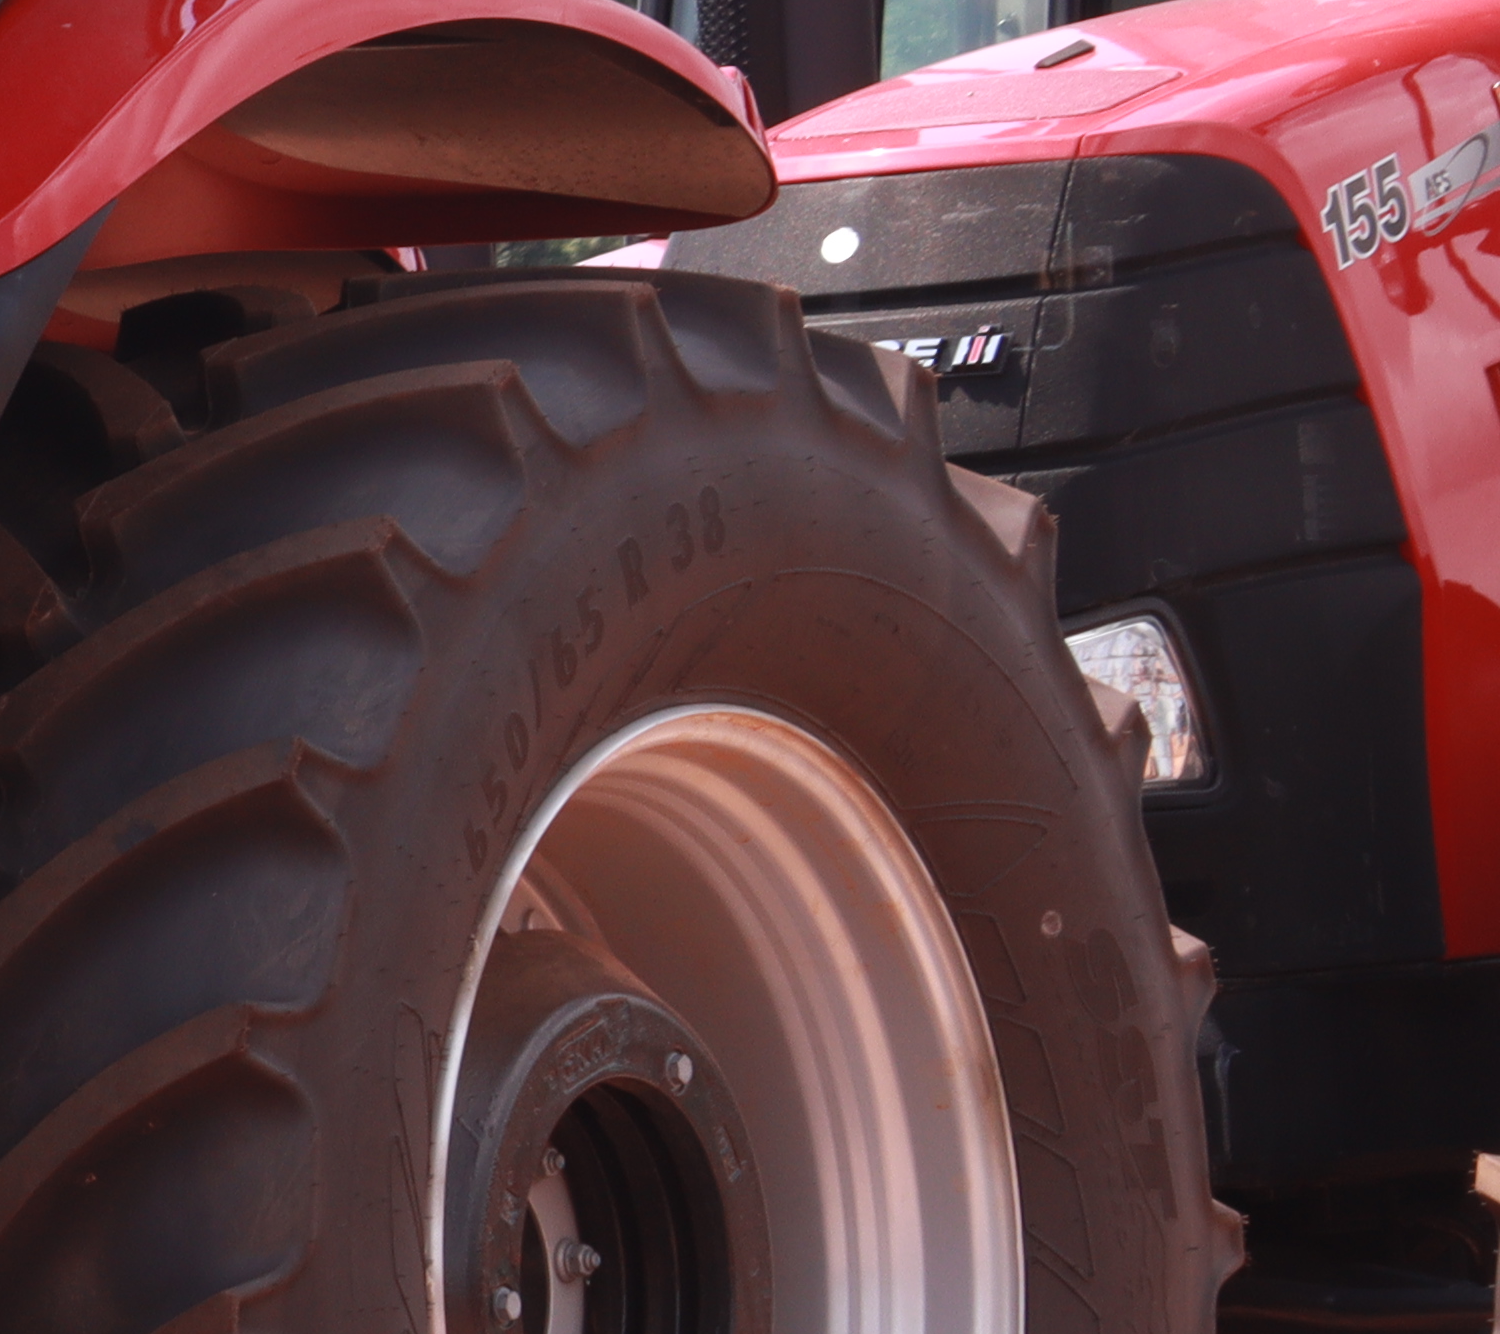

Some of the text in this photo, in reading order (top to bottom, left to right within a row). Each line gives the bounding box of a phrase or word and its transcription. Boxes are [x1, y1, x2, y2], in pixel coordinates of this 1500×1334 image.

[1320, 152, 1453, 271] 155 AFS
[667, 484, 727, 571] 38
